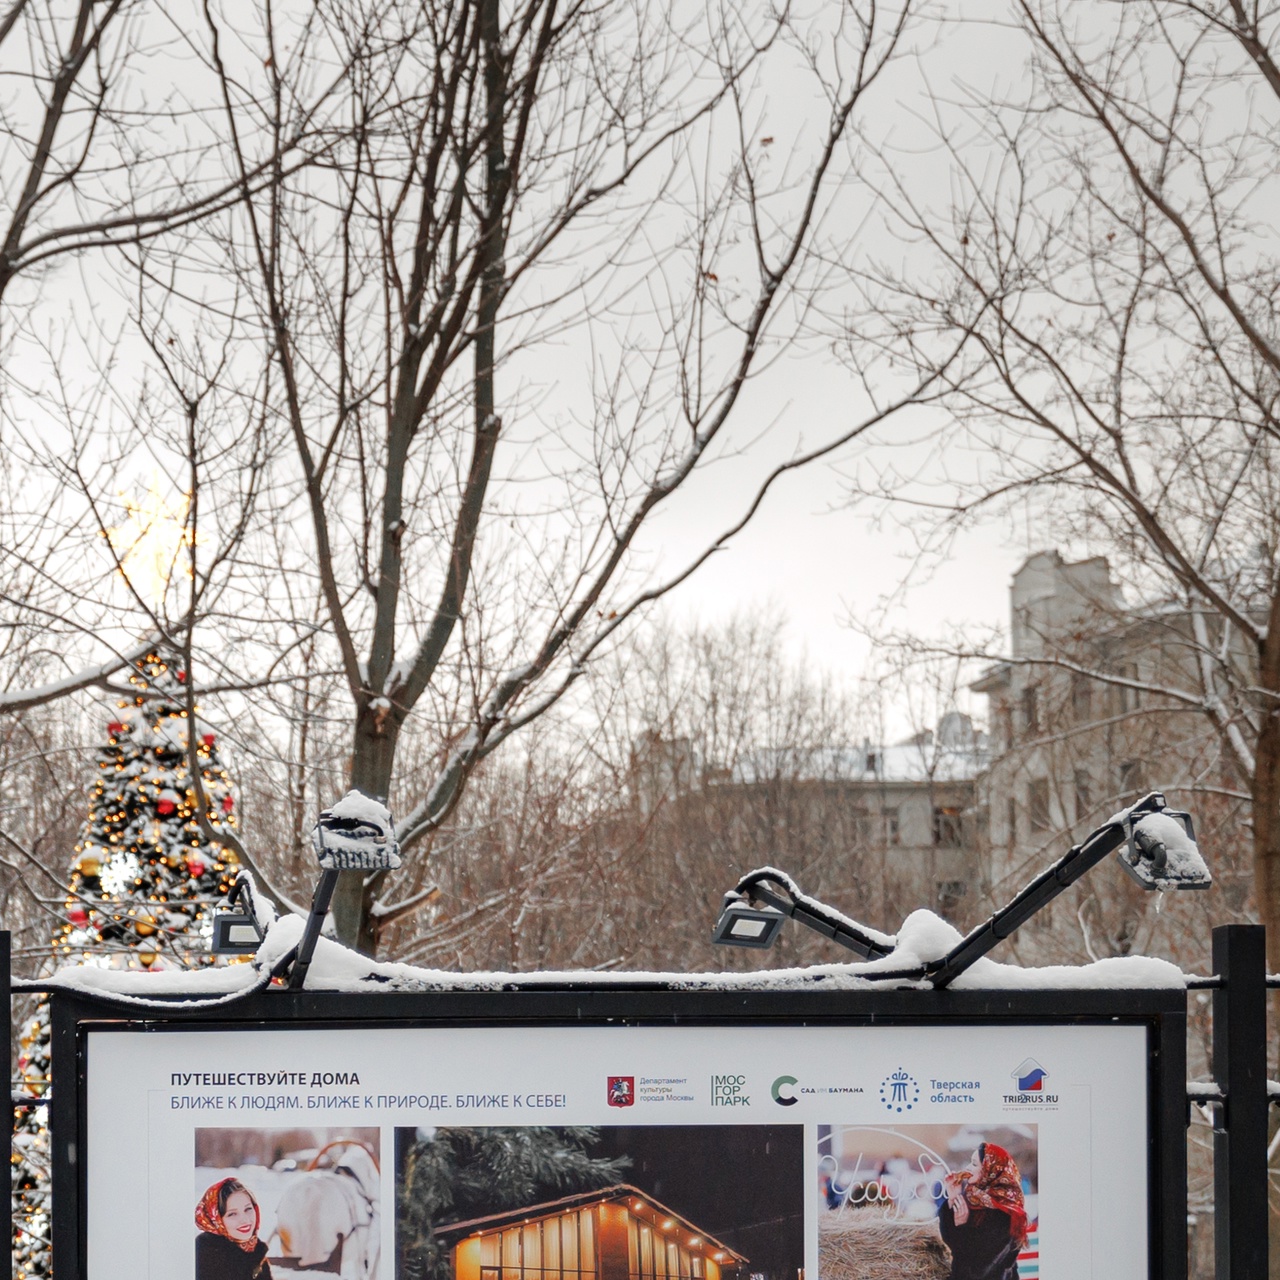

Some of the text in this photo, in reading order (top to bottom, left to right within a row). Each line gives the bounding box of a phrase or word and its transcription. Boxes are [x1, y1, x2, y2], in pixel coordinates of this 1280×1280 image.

[171, 1070, 360, 1088] ПУТЕШЕСТВУЙТЕ ДОМА
[715, 1075, 745, 1085] МОС
[715, 1086, 740, 1095] ГОР
[930, 1080, 980, 1091] Тверская
[171, 1094, 566, 1111] БЛИЖЕ К ЛЮДЯМ. БЛИЖЕ К ПРИРОДЕ. БЛИЖЕ К СЕБЕ!
[715, 1096, 750, 1106] ПАРК
[930, 1093, 974, 1103] область
